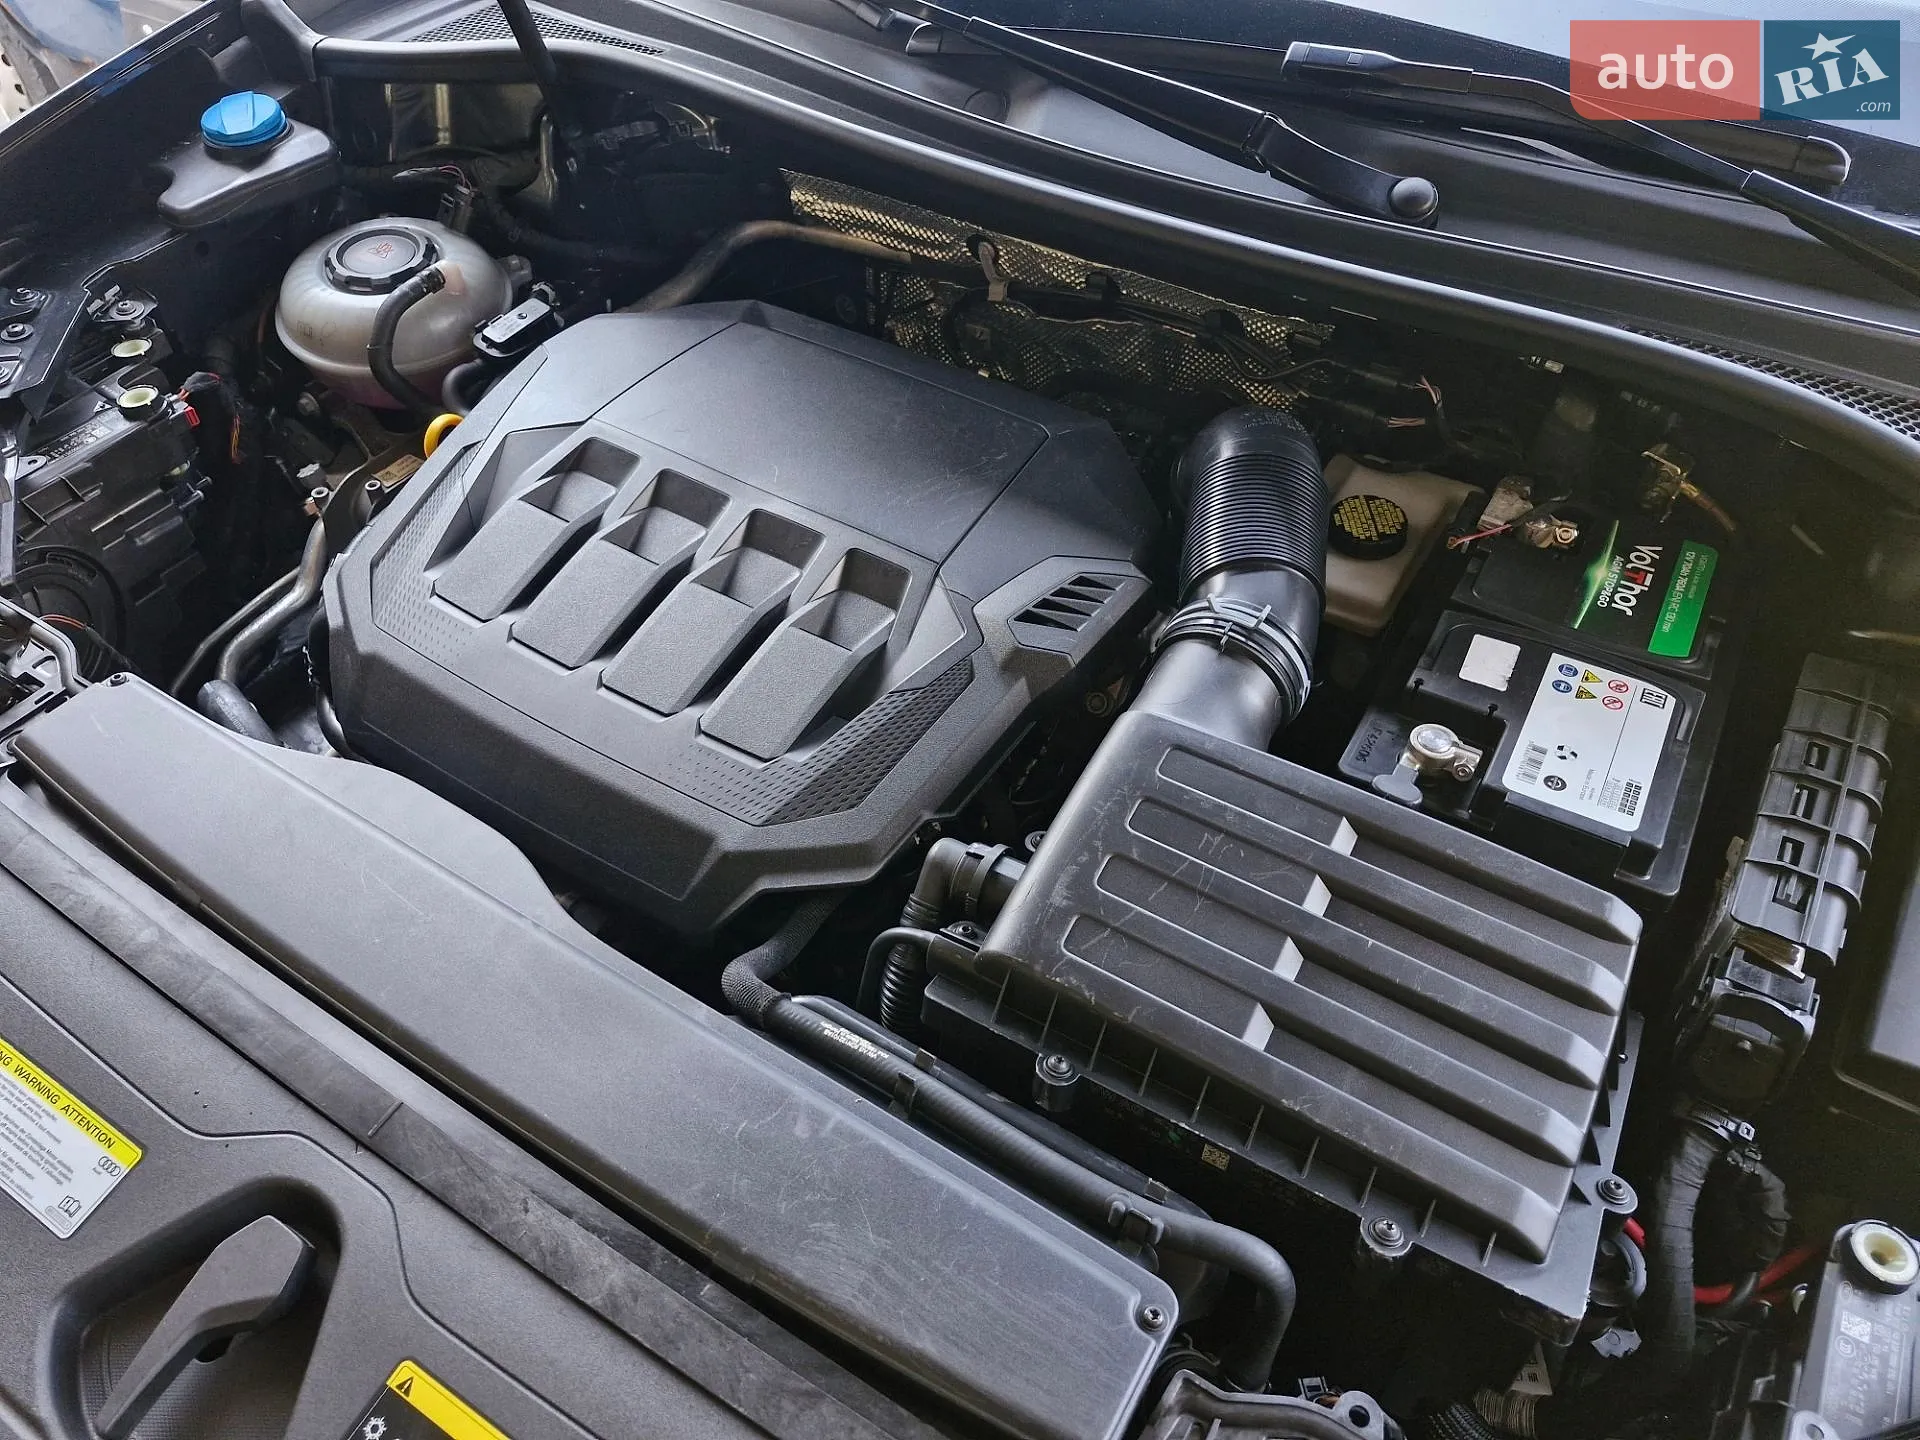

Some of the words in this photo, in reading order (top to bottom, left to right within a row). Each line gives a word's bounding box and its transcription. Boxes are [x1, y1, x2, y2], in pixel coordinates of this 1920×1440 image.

[1611, 555, 1623, 572] AGM
[1597, 573, 1618, 607] STOP&GO
[14, 1064, 61, 1105] WARNING
[60, 1104, 116, 1149] ATTENTION
